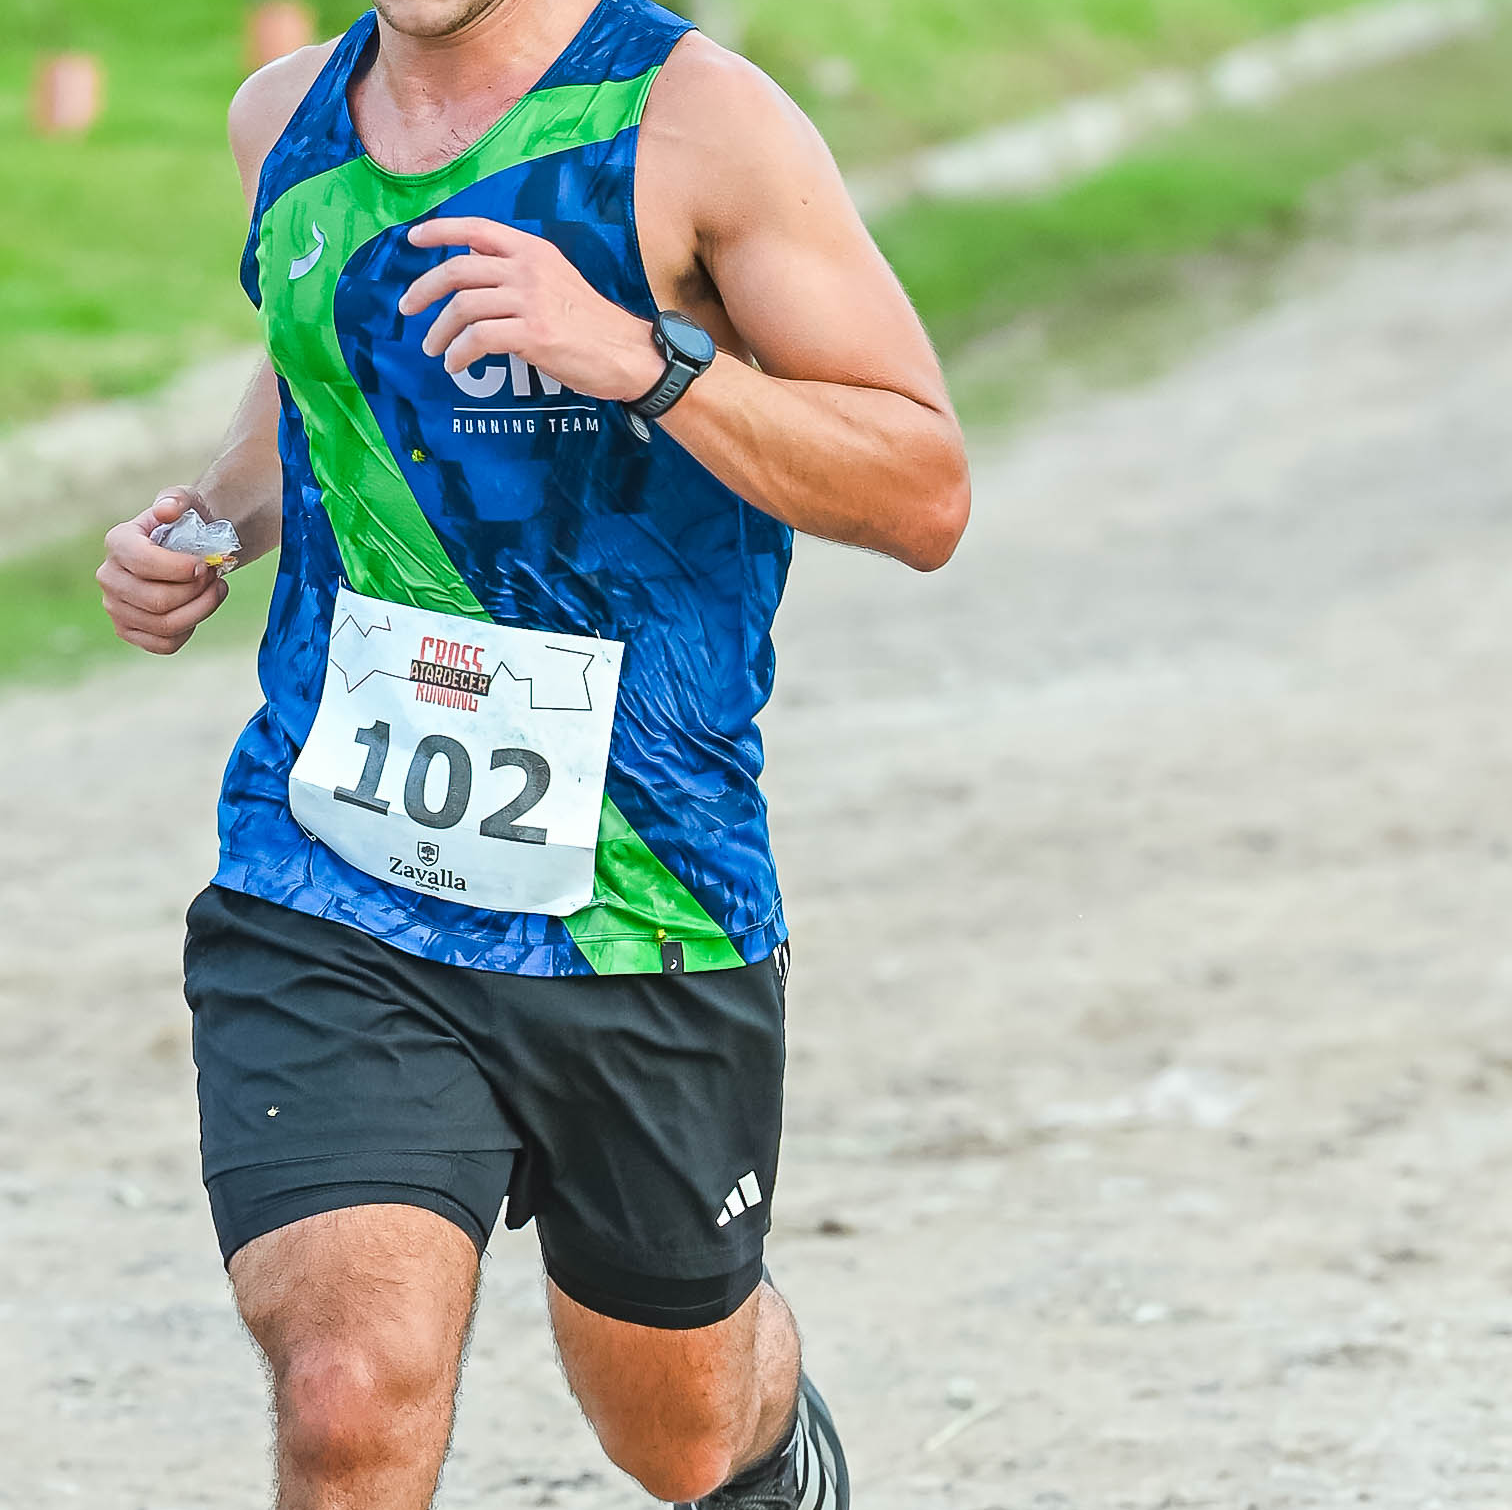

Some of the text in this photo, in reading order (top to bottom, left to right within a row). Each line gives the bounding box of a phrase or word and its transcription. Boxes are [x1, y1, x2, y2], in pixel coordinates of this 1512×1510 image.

[452, 417, 599, 434] RUNNING TEAM
[419, 636, 485, 673] CROSS
[410, 661, 489, 694] ATARDECER
[415, 682, 479, 712] RUNNING
[333, 719, 551, 846] 102
[389, 856, 467, 891] Zavalla
